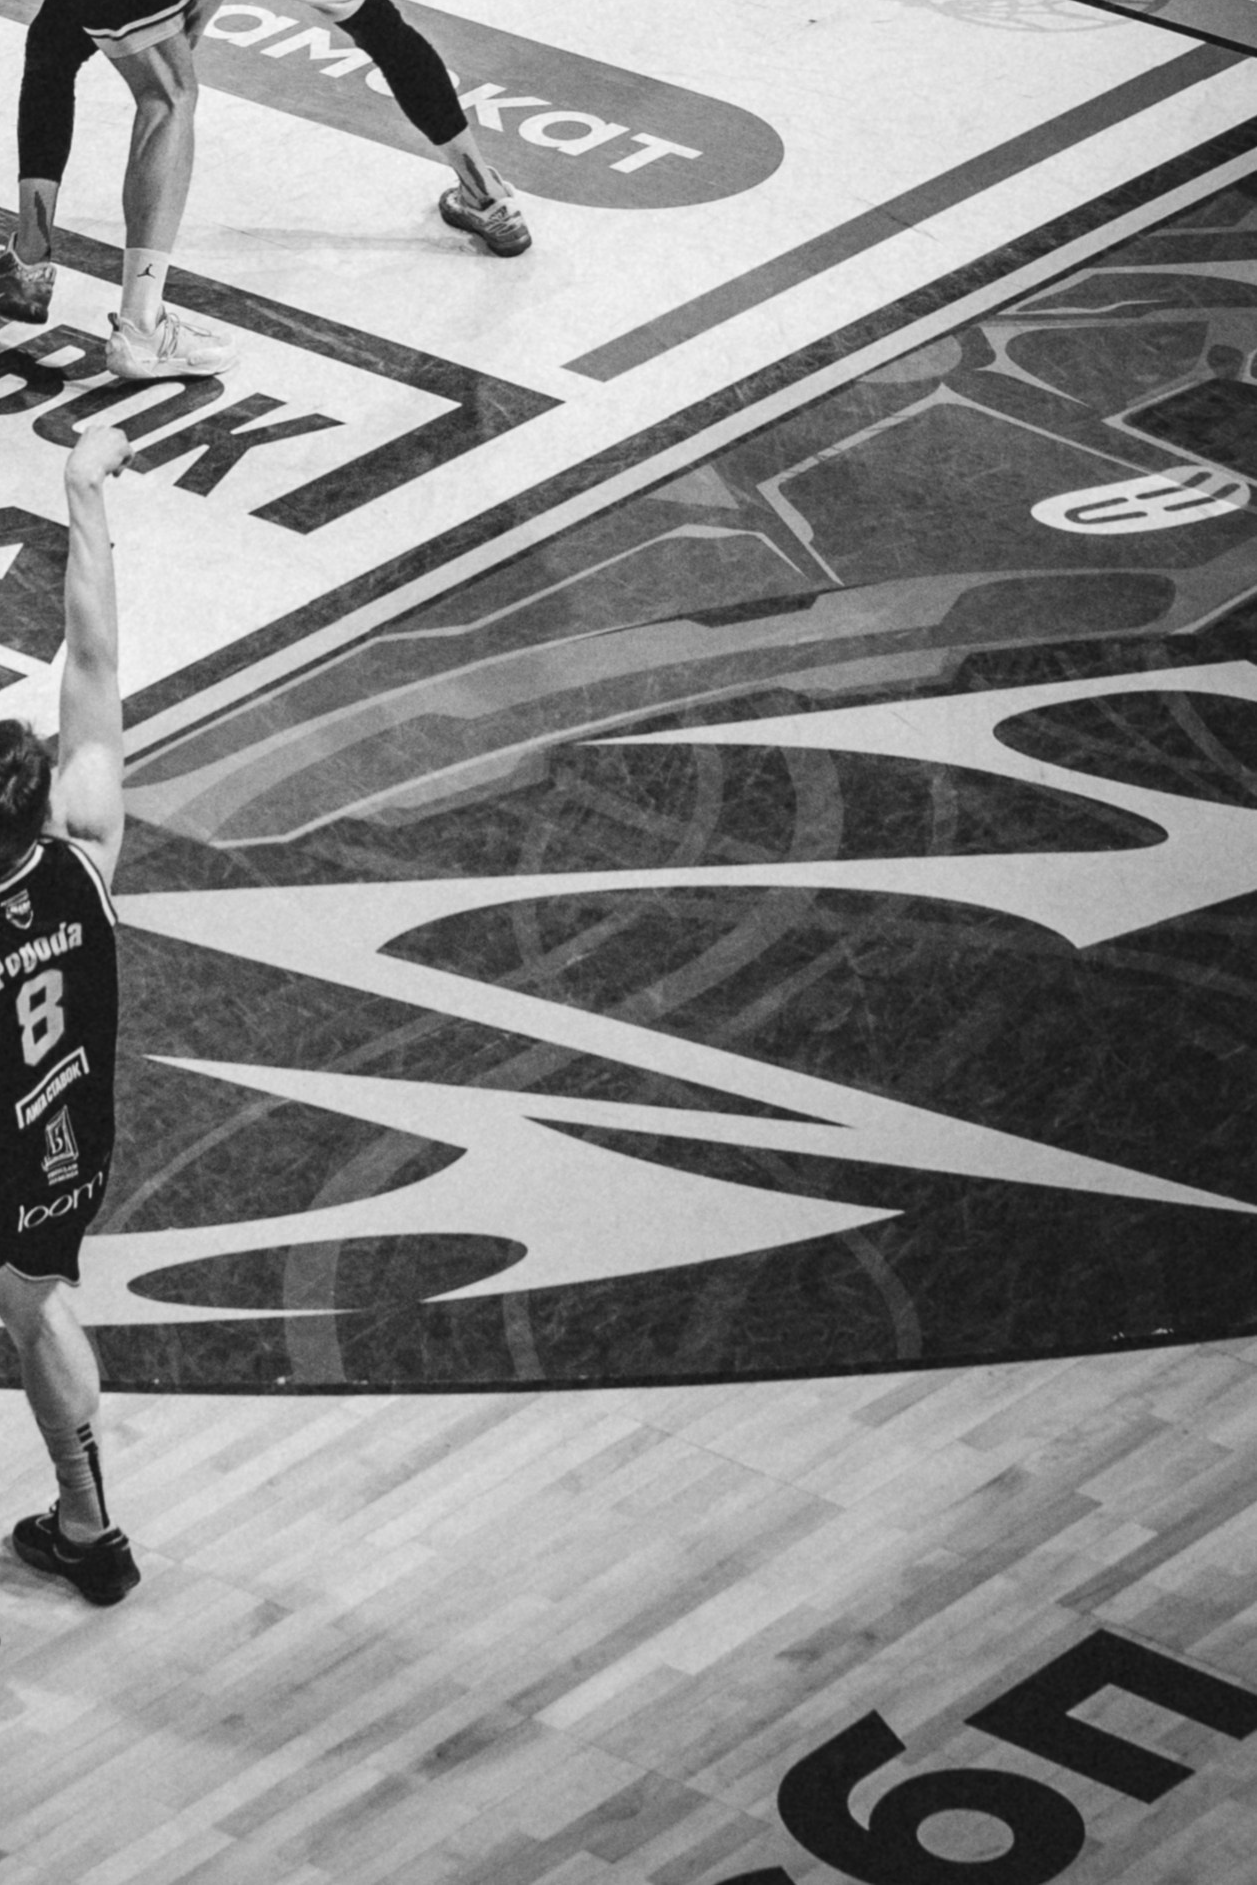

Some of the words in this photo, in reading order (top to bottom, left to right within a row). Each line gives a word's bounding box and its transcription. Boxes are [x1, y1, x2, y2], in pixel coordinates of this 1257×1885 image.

[15, 968, 65, 1067] 8
[25, 1093, 48, 1126] ЛИГА
[45, 1061, 82, 1103] СТАВОК
